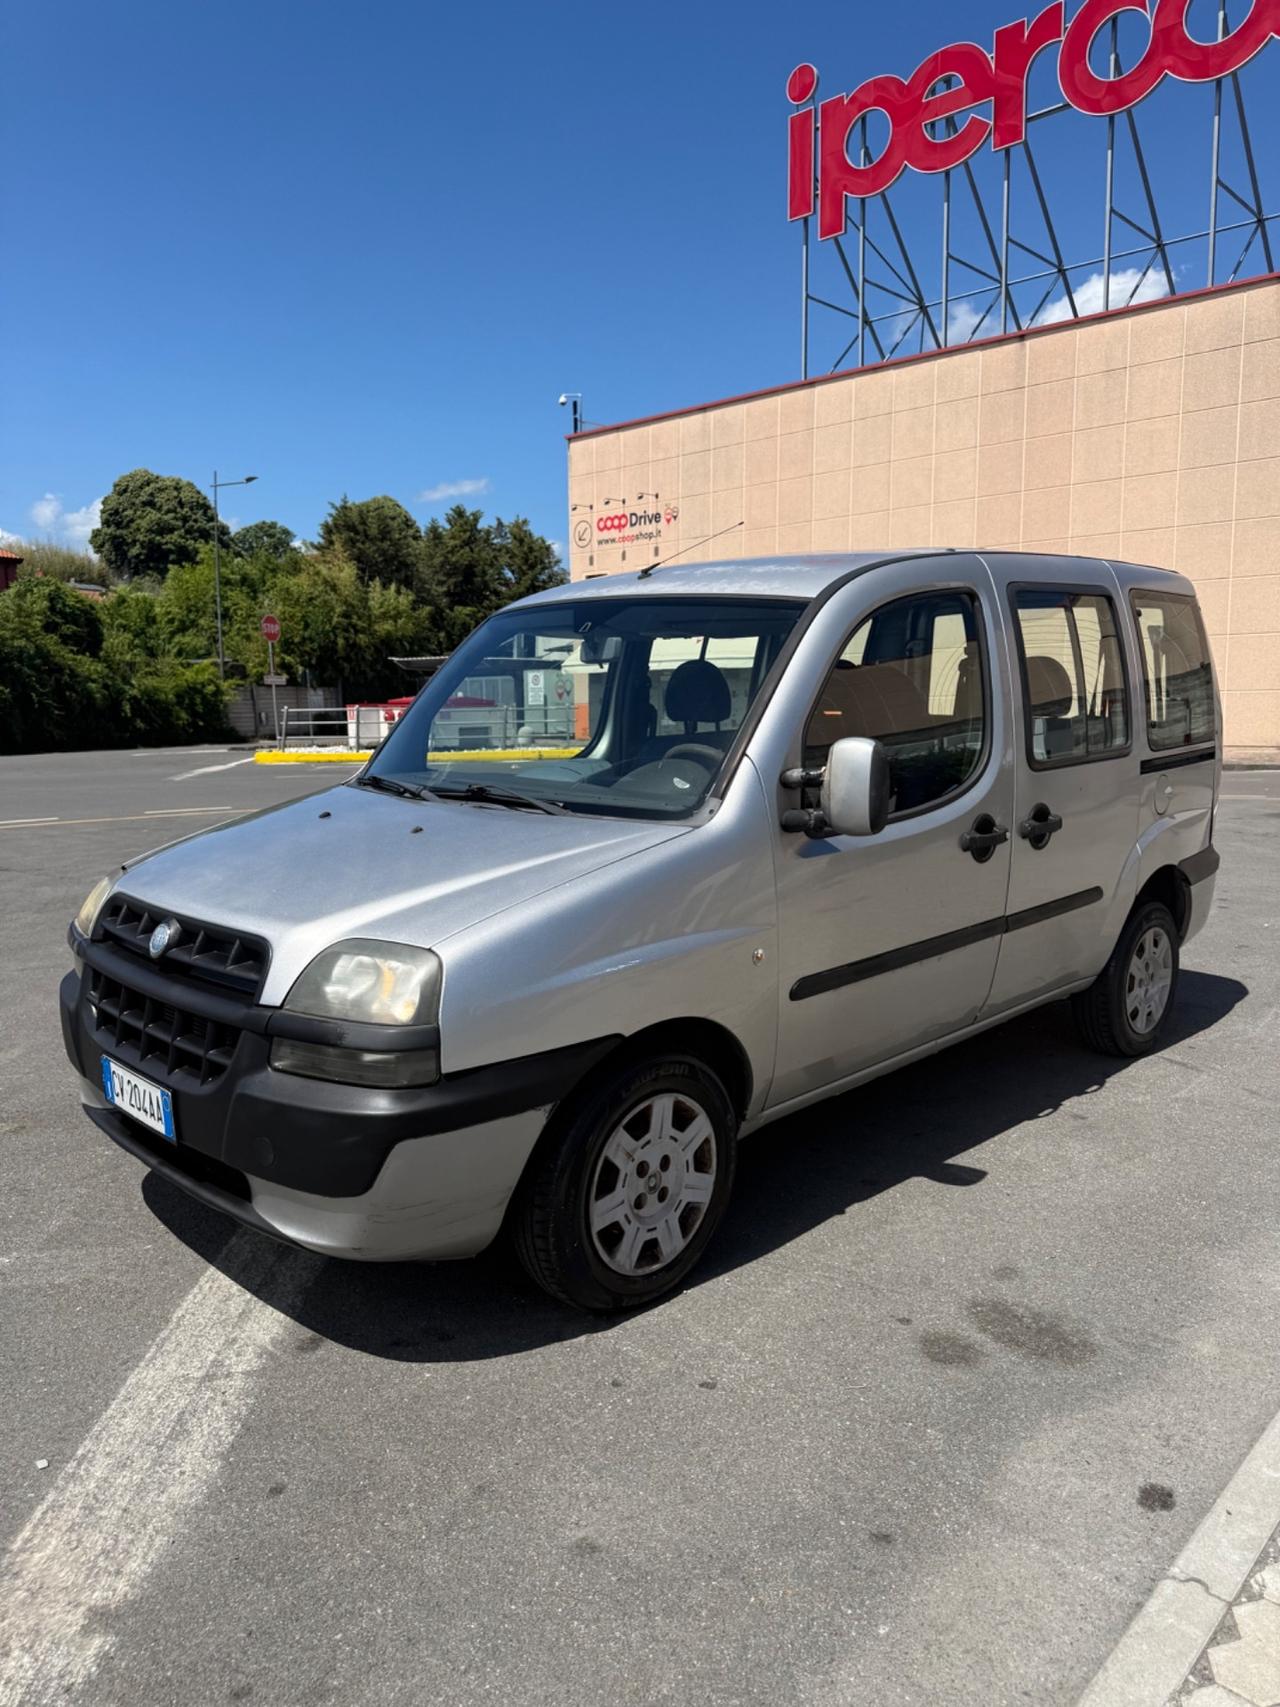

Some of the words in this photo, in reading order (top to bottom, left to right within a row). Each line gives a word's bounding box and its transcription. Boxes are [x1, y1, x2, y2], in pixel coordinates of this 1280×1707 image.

[786, 0, 1280, 241] iperco
[597, 514, 628, 532] coop
[629, 510, 661, 527] Drive
[597, 530, 661, 545] www.coopshop.it
[262, 623, 280, 633] STOP
[127, 1079, 163, 1124] 204AA
